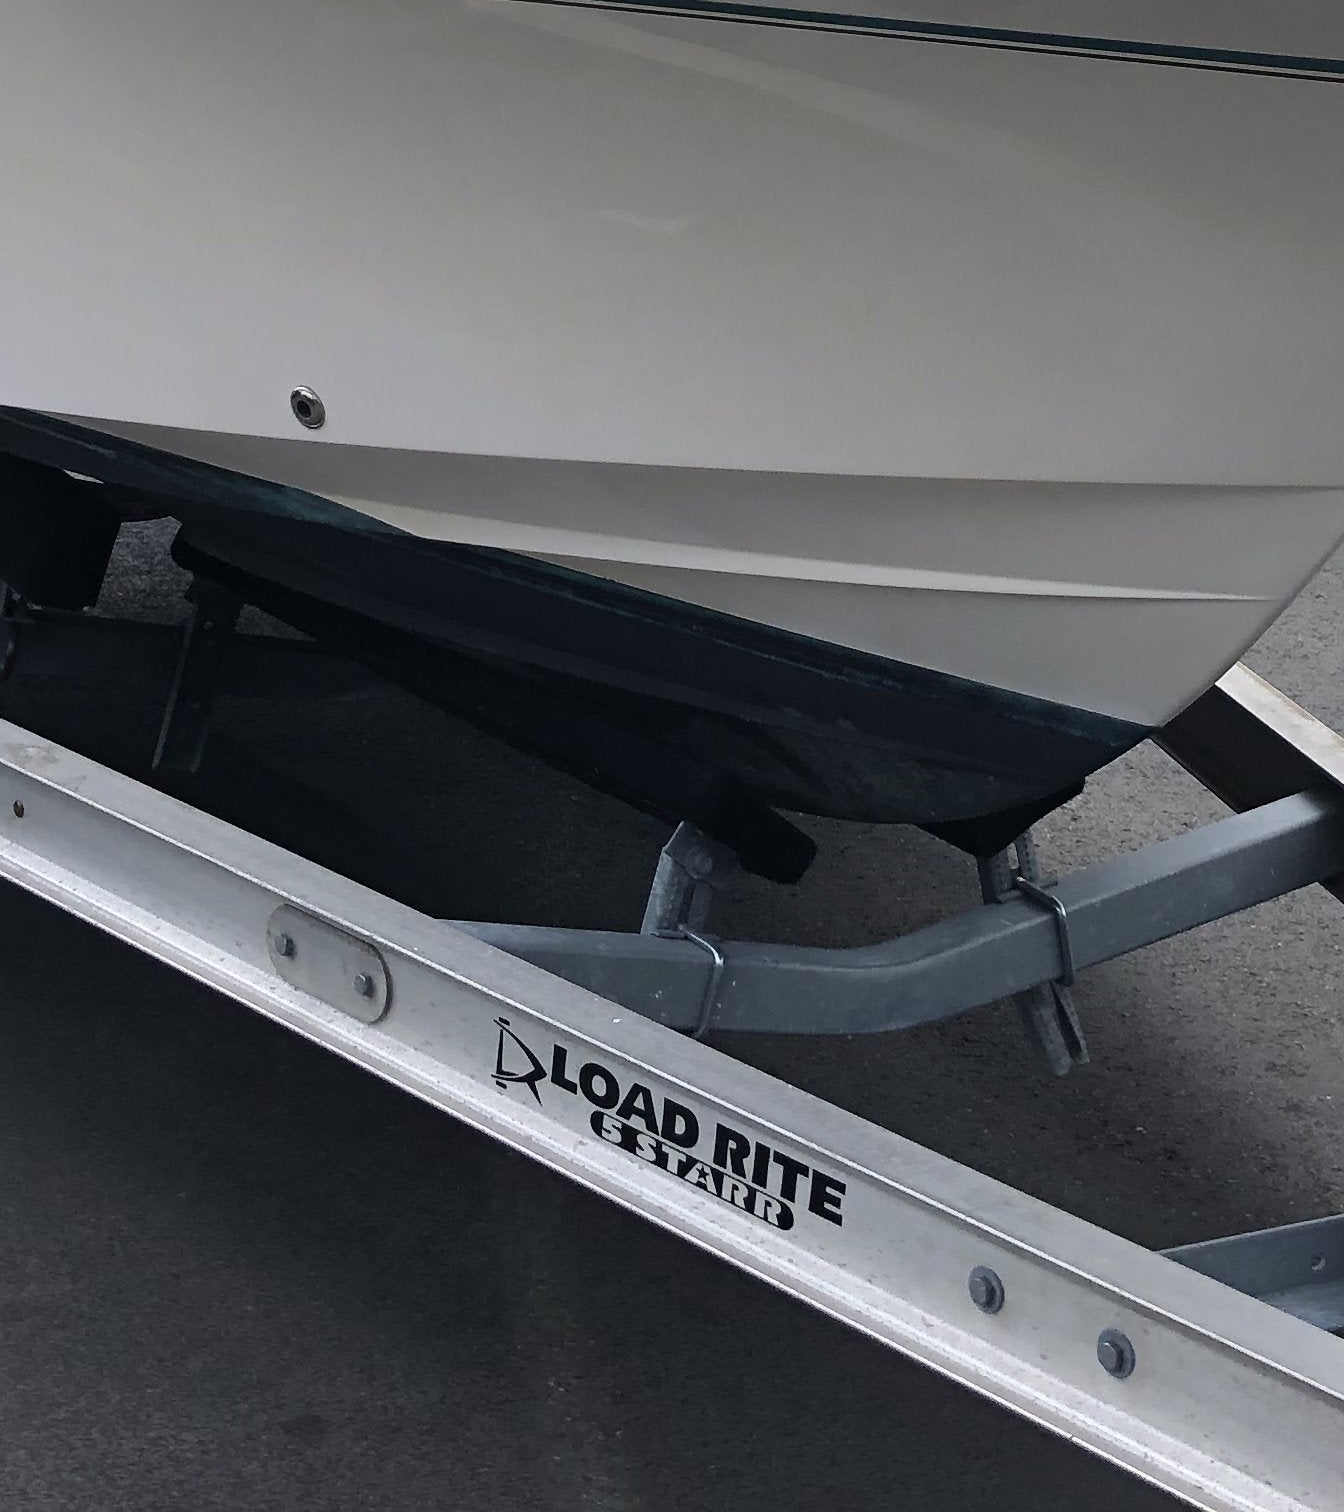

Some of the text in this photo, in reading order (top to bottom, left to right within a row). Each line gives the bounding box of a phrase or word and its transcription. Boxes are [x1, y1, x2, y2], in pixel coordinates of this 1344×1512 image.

[550, 1043, 847, 1227] LOAD RITE
[600, 1114, 782, 1227] 5 STARR
